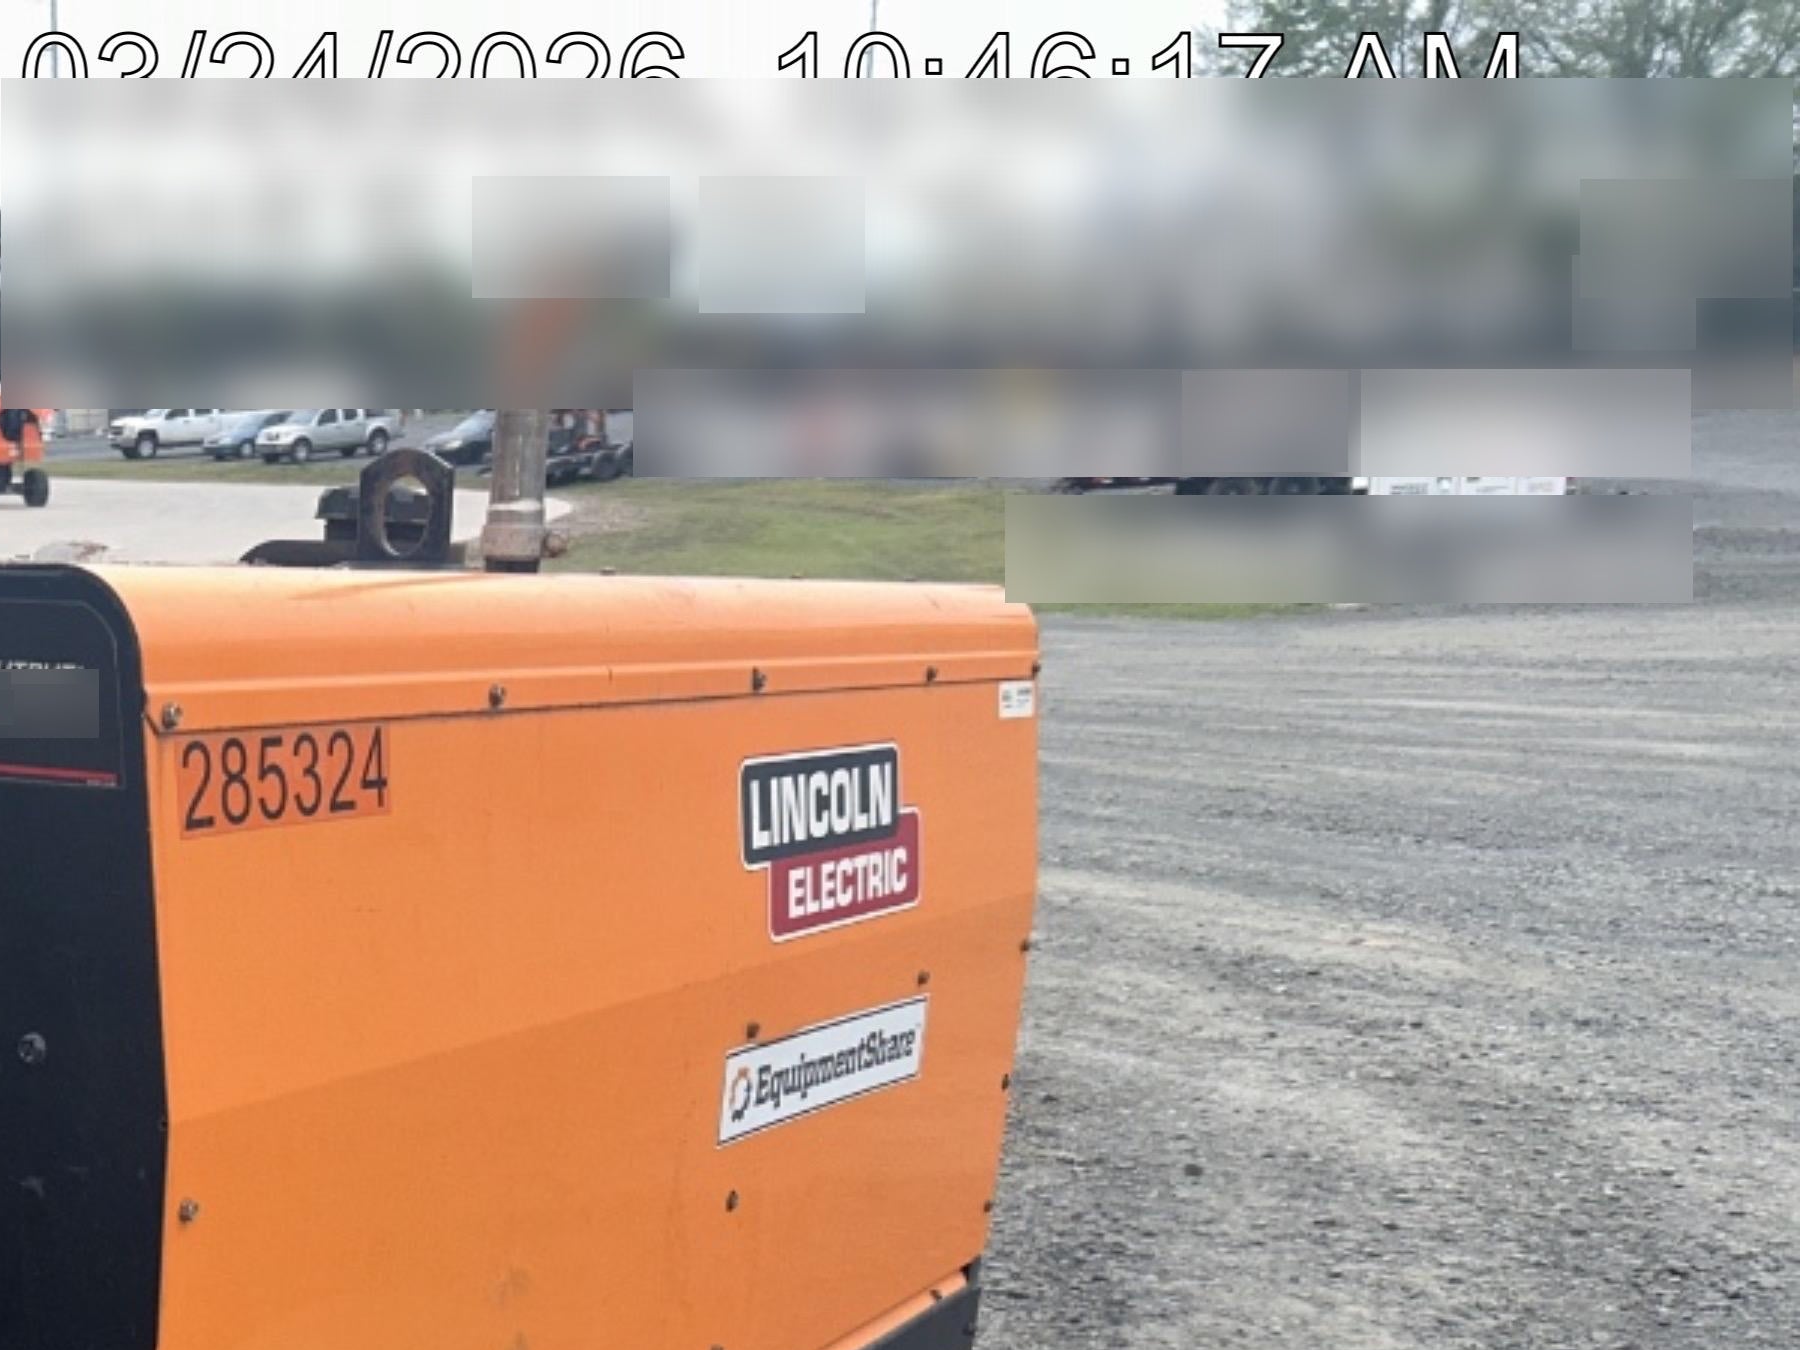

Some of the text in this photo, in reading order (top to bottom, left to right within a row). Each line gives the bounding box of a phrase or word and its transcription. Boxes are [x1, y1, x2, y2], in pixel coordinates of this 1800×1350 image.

[181, 725, 388, 831] 285324
[749, 761, 893, 850] LINCOLN
[787, 846, 908, 919] ELECTRIC
[753, 1028, 916, 1109] EquipmentShare
